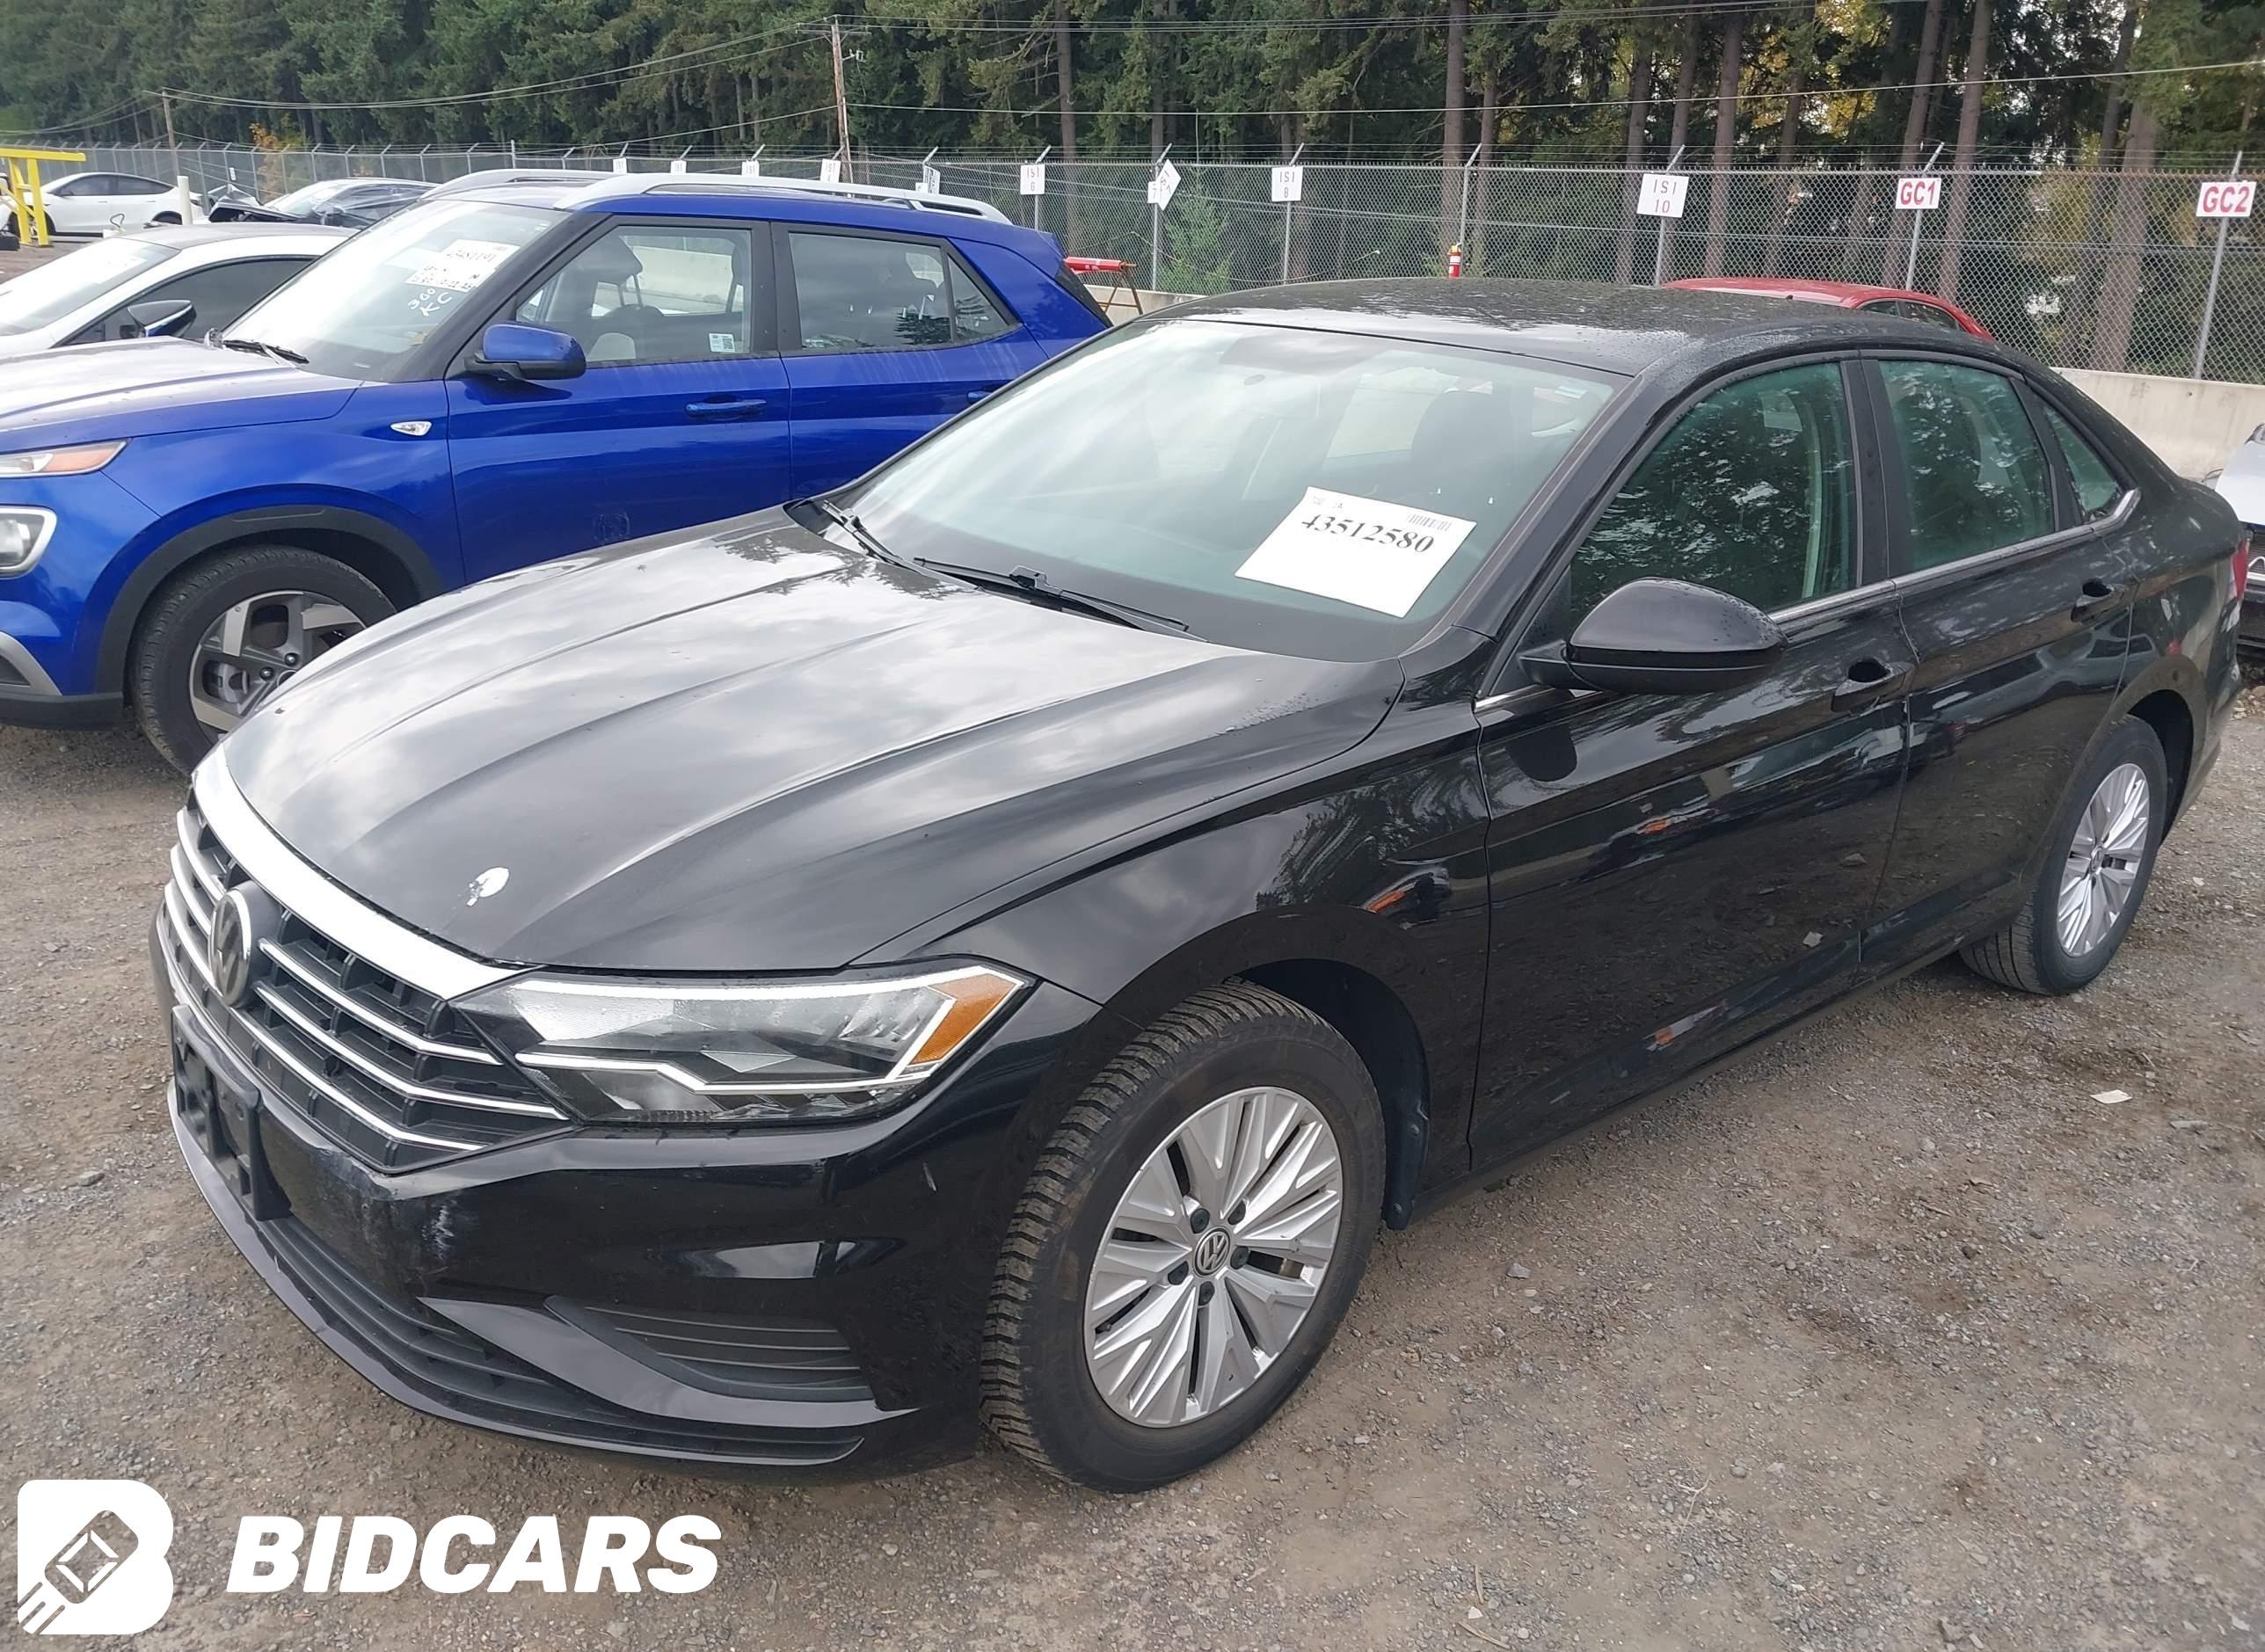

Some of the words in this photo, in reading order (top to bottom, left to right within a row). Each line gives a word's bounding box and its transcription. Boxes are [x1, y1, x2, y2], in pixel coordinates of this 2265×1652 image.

[1900, 180, 1936, 206] GC1
[2203, 186, 2250, 213] GC2
[1655, 199, 1671, 214] 10
[1301, 513, 1435, 553] 43512580
